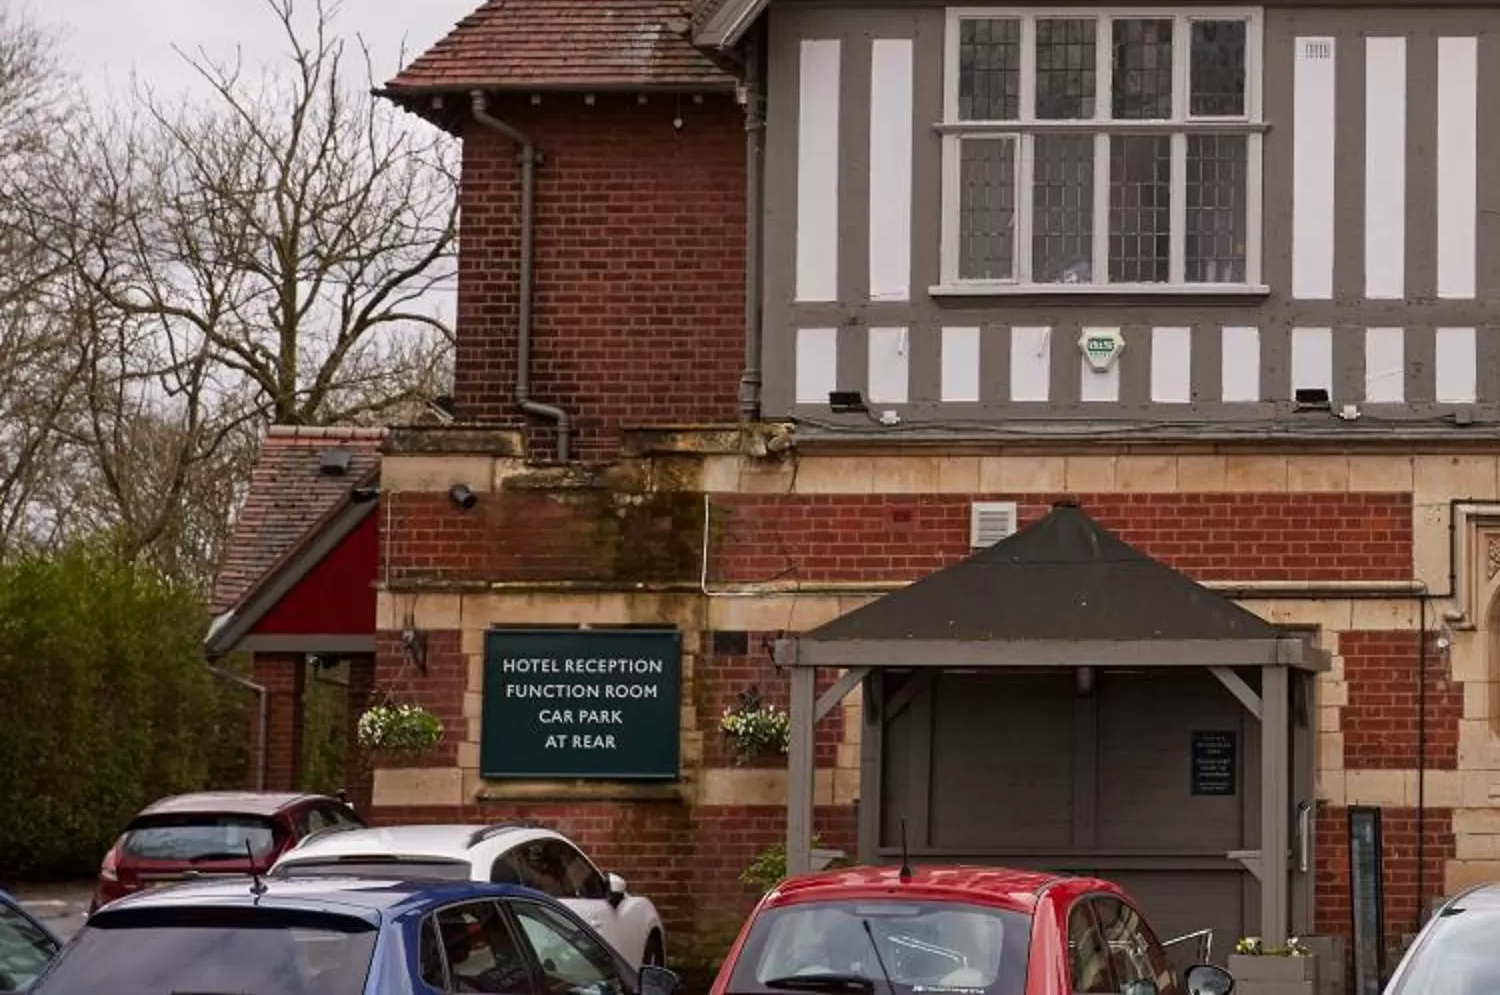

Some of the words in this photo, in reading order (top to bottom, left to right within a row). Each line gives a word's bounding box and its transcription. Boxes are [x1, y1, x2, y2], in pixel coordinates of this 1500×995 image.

[503, 658, 560, 674] HOTEL
[564, 658, 663, 674] RECEPTION
[506, 684, 599, 698] FUNCTION
[605, 684, 657, 698] ROOM
[538, 709, 574, 724] CAR
[579, 709, 623, 724] PARK
[545, 734, 567, 749] AT
[572, 734, 616, 749] REAR
